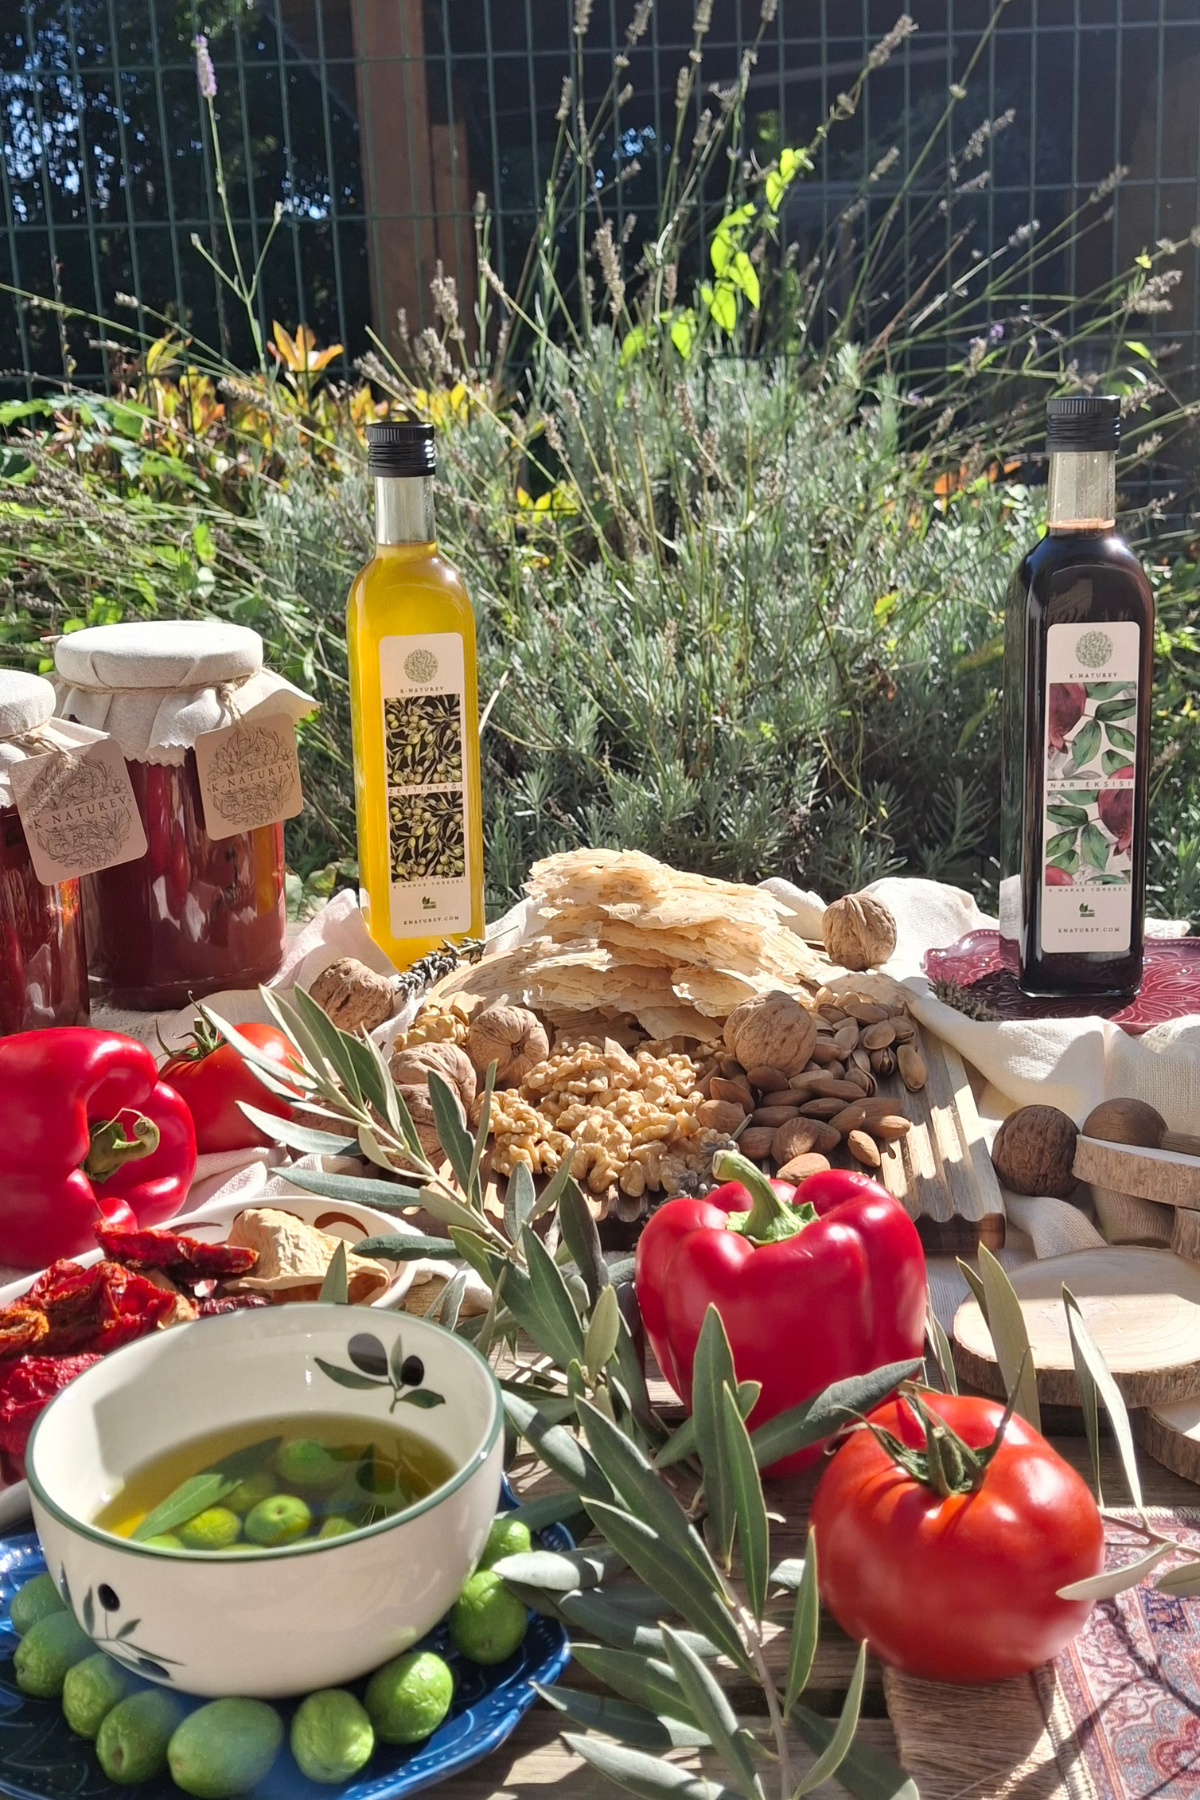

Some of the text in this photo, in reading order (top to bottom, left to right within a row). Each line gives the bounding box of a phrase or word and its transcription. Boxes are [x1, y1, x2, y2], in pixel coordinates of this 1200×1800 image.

[400, 686, 444, 694] K-NATUREV
[211, 762, 293, 792] K-NATUREV
[33, 795, 127, 830] K-NATUREV
[403, 915, 460, 926] KNATUREV.COM
